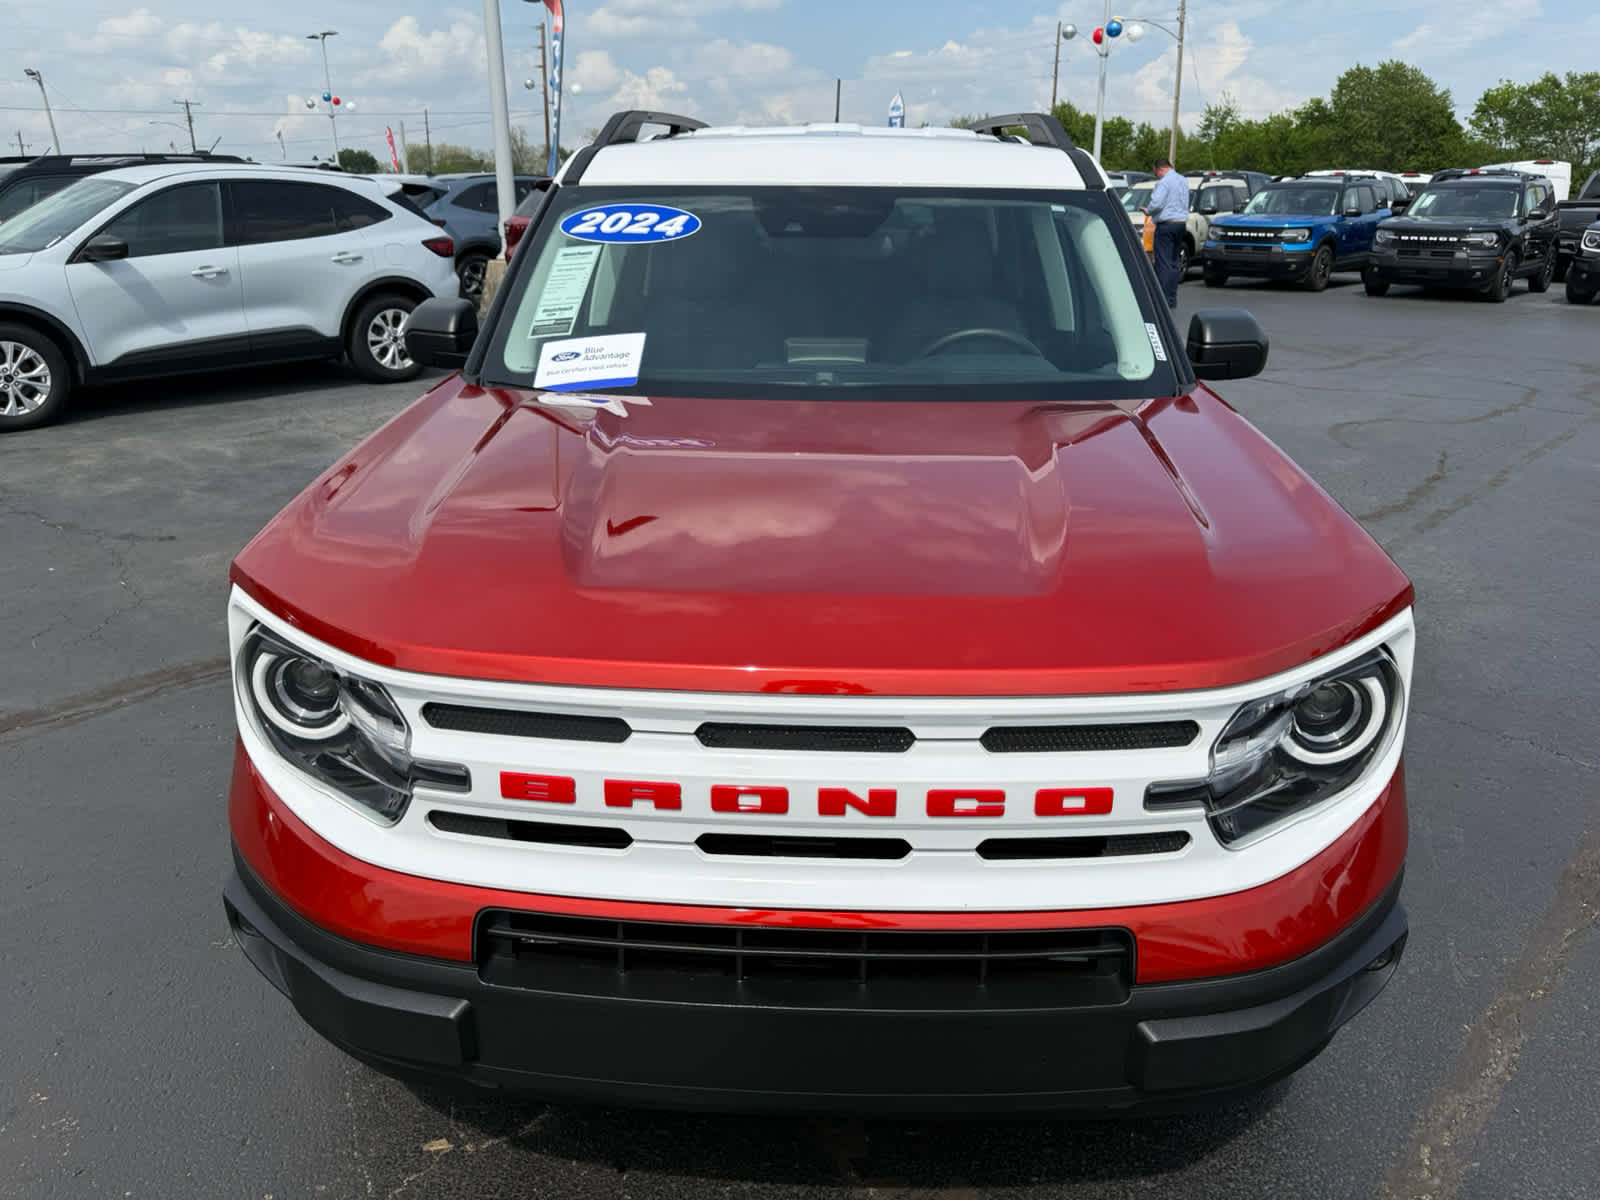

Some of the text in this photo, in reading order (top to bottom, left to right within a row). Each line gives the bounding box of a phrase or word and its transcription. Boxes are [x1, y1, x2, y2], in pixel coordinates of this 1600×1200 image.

[569, 212, 690, 236] 2024
[584, 352, 630, 361] Advantage
[585, 346, 605, 354] Blue
[499, 771, 1114, 818] BRONCO
